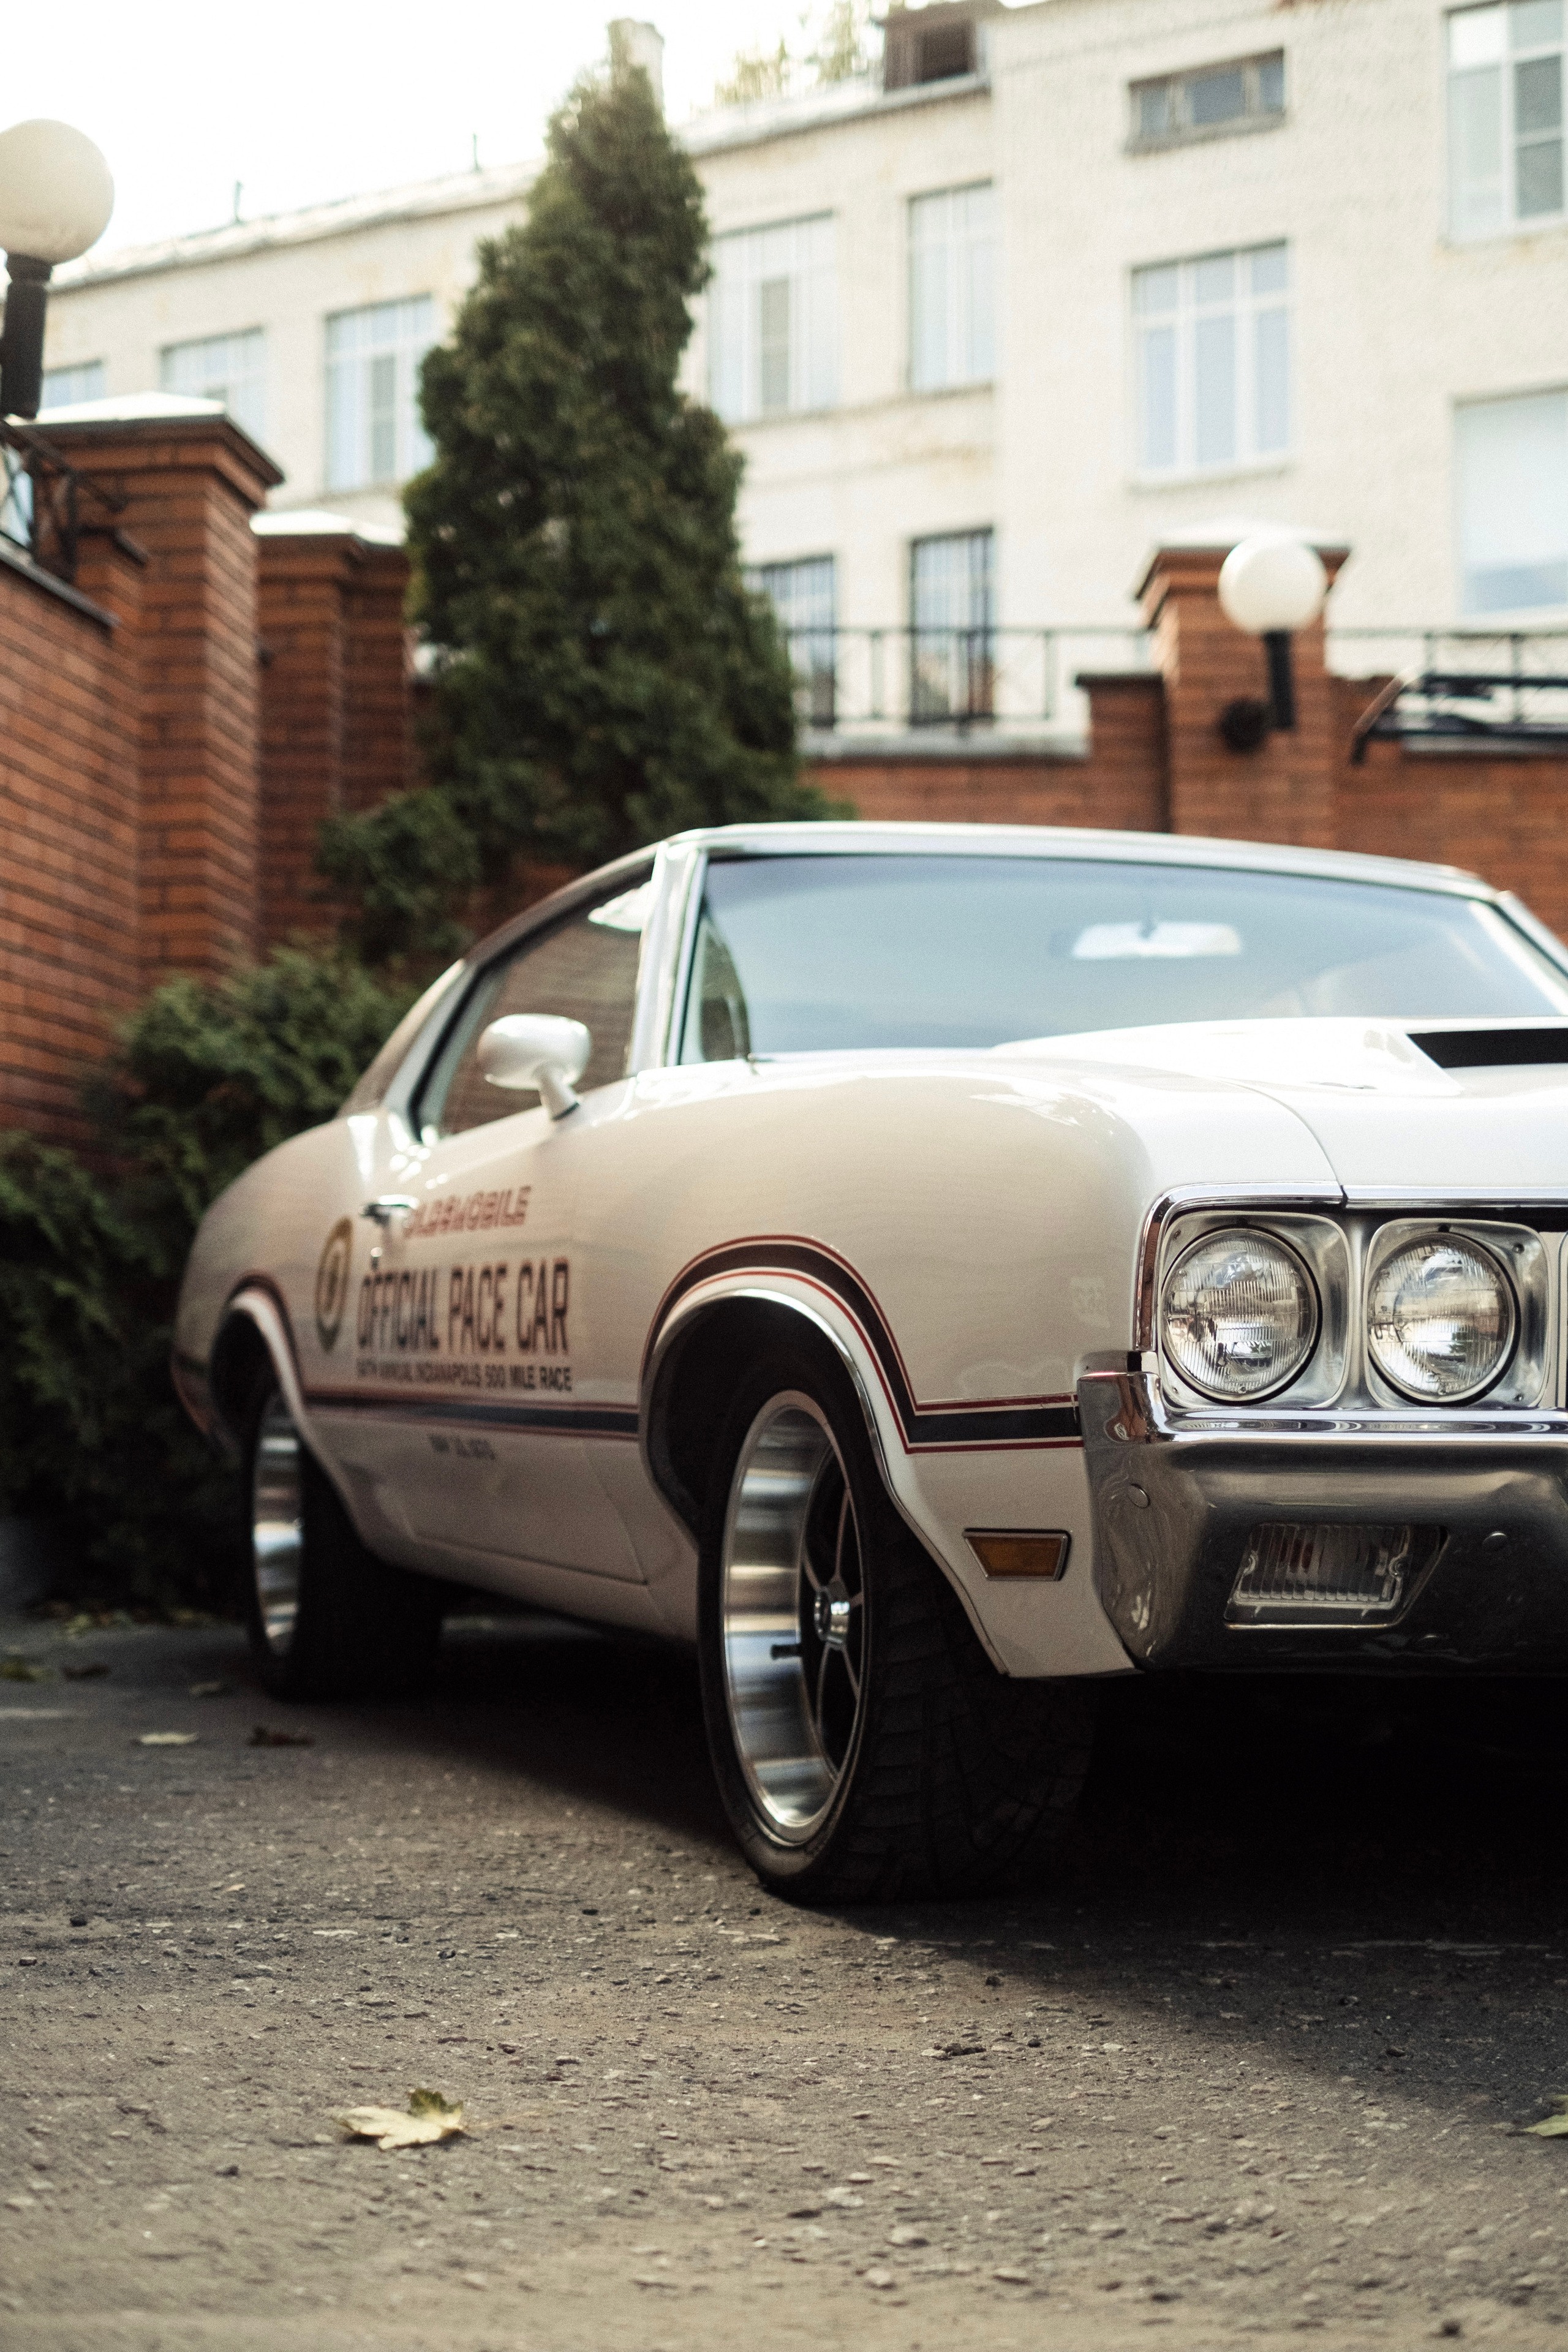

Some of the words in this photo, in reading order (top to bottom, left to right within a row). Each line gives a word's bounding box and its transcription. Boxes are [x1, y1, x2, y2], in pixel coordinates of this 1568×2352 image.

[448, 1264, 507, 1354] PACE
[517, 1257, 568, 1354] CAR
[539, 1366, 571, 1392] RACE
